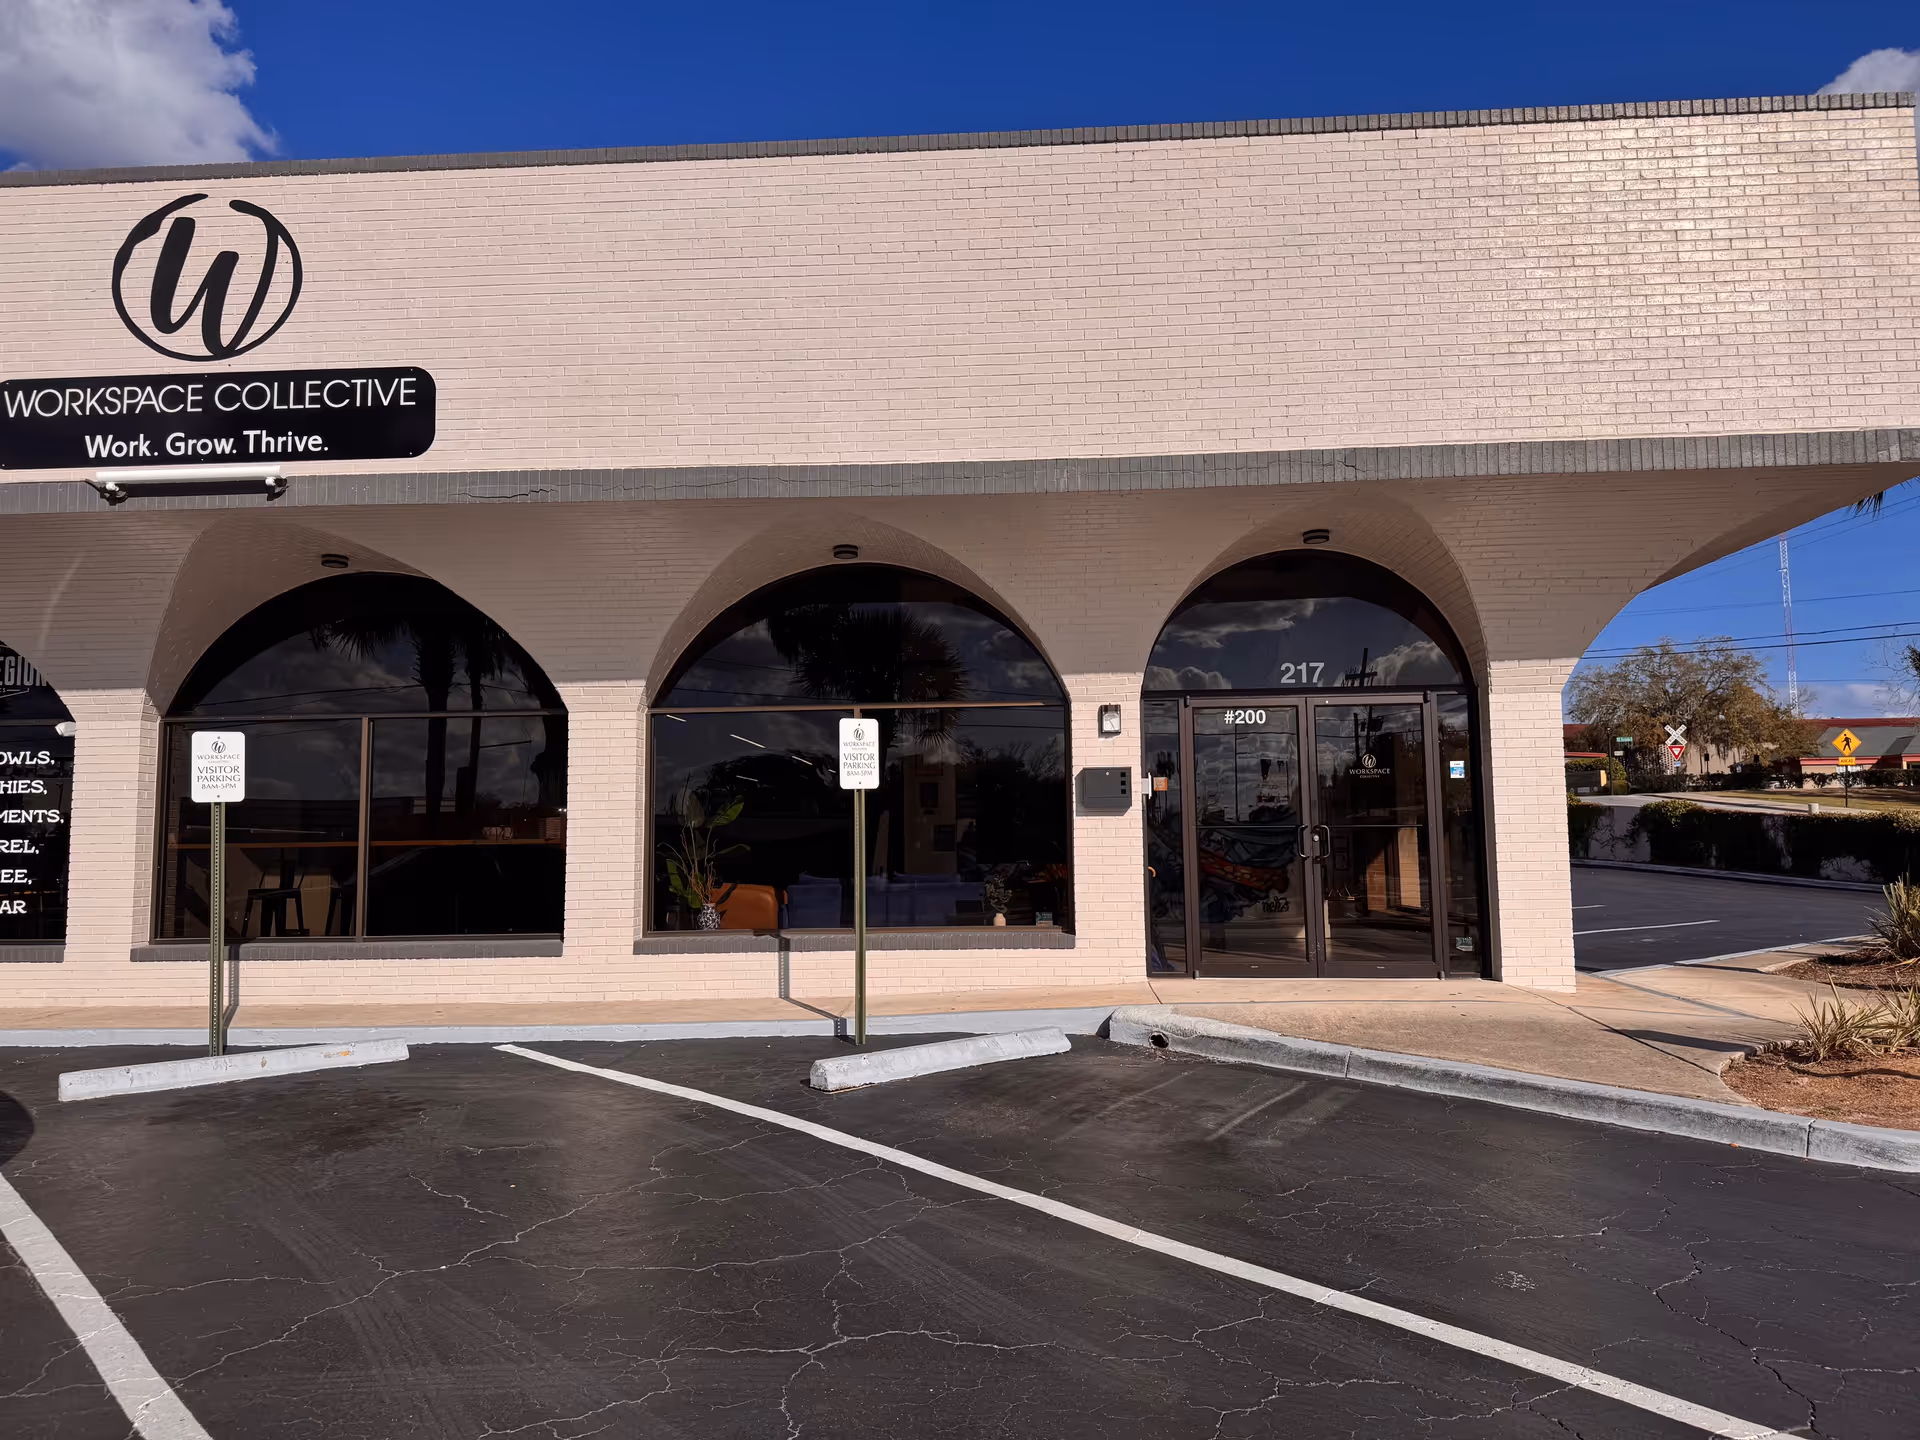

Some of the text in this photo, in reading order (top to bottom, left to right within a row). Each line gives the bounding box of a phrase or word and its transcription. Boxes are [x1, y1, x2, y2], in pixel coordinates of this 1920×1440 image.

[4, 377, 417, 418] WORKSPACE COLLECTIVE
[84, 429, 329, 458] Work. Grow. Thrive.
[1280, 662, 1325, 684] 217
[1223, 709, 1267, 725] #200
[843, 753, 875, 761] VISITOR
[197, 765, 240, 774] VISITOR
[843, 762, 876, 770] PARKING
[197, 774, 241, 782] PARKING
